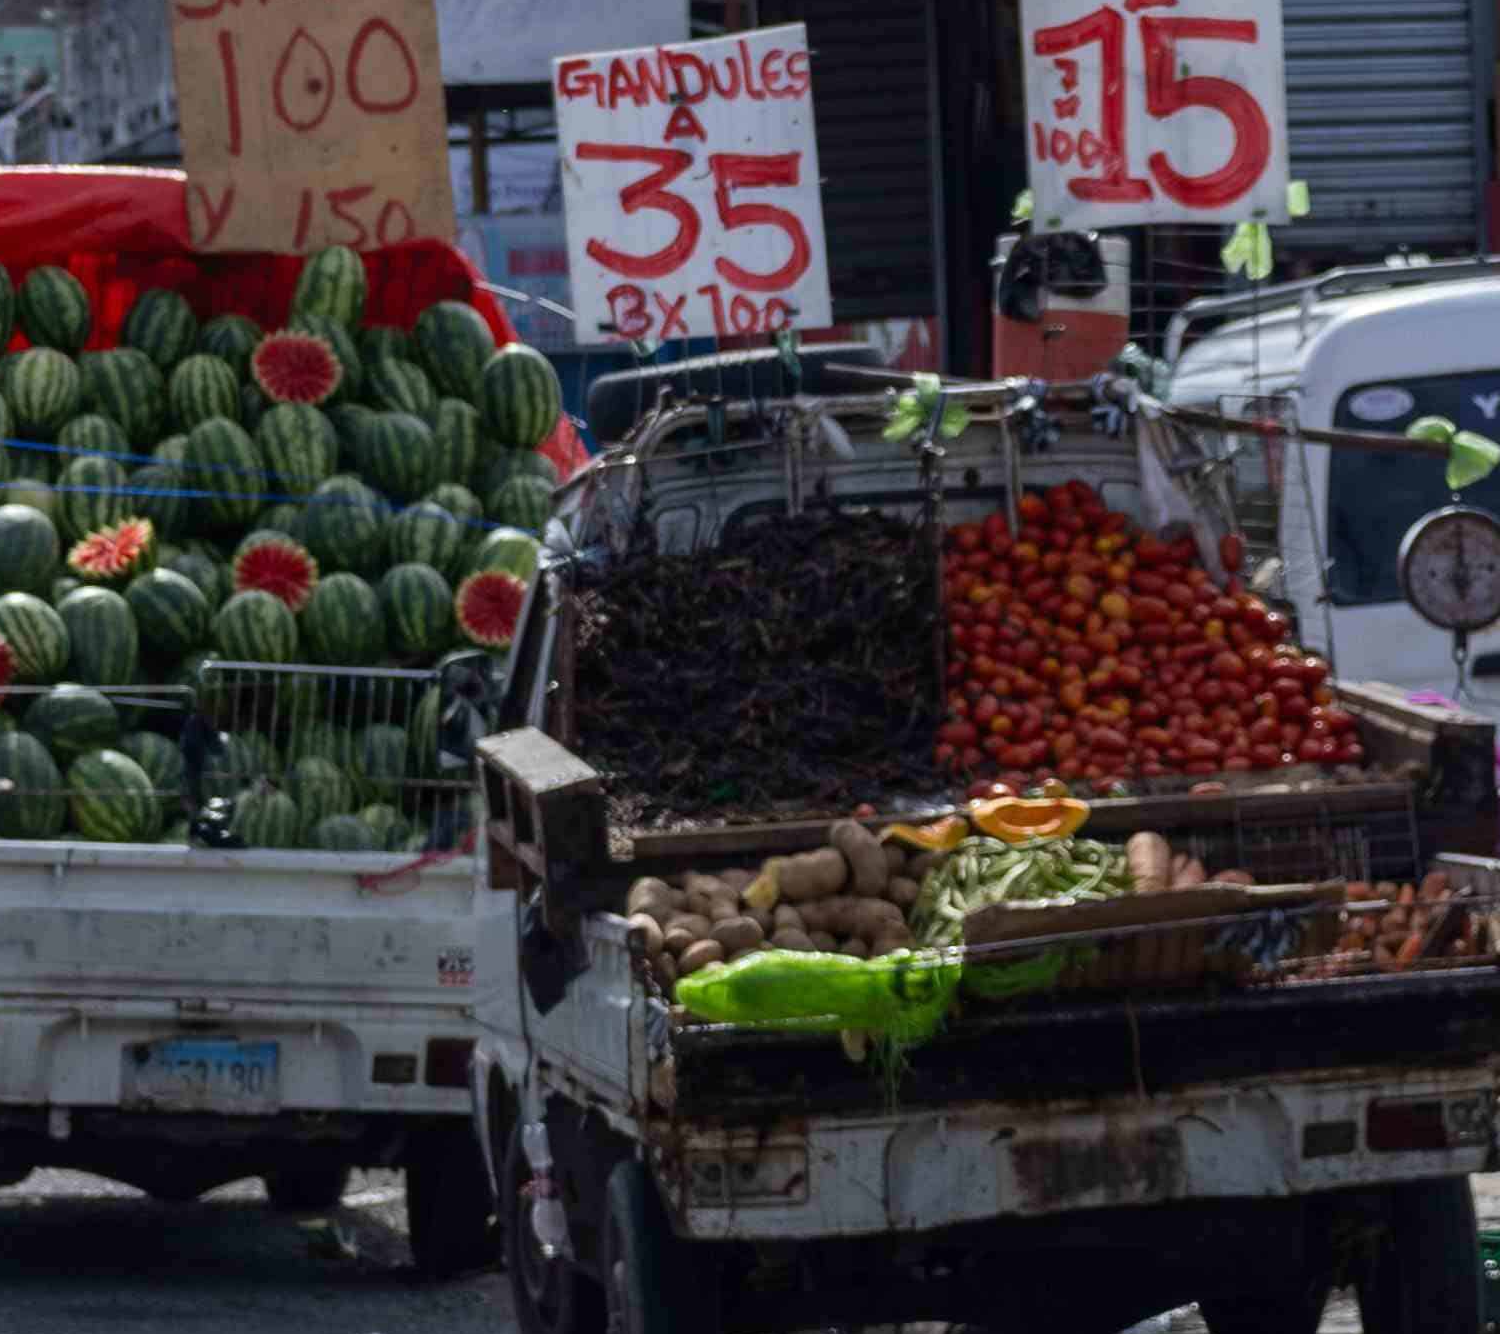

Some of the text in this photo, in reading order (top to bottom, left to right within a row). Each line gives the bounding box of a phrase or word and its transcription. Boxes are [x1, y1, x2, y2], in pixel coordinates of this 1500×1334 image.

[218, 17, 419, 157] 100
[557, 39, 811, 109] GANDULES
[1033, 4, 1272, 210] 15
[663, 105, 708, 143] A
[1033, 122, 1108, 170] 100
[293, 185, 416, 250] 150
[575, 142, 811, 293] 35
